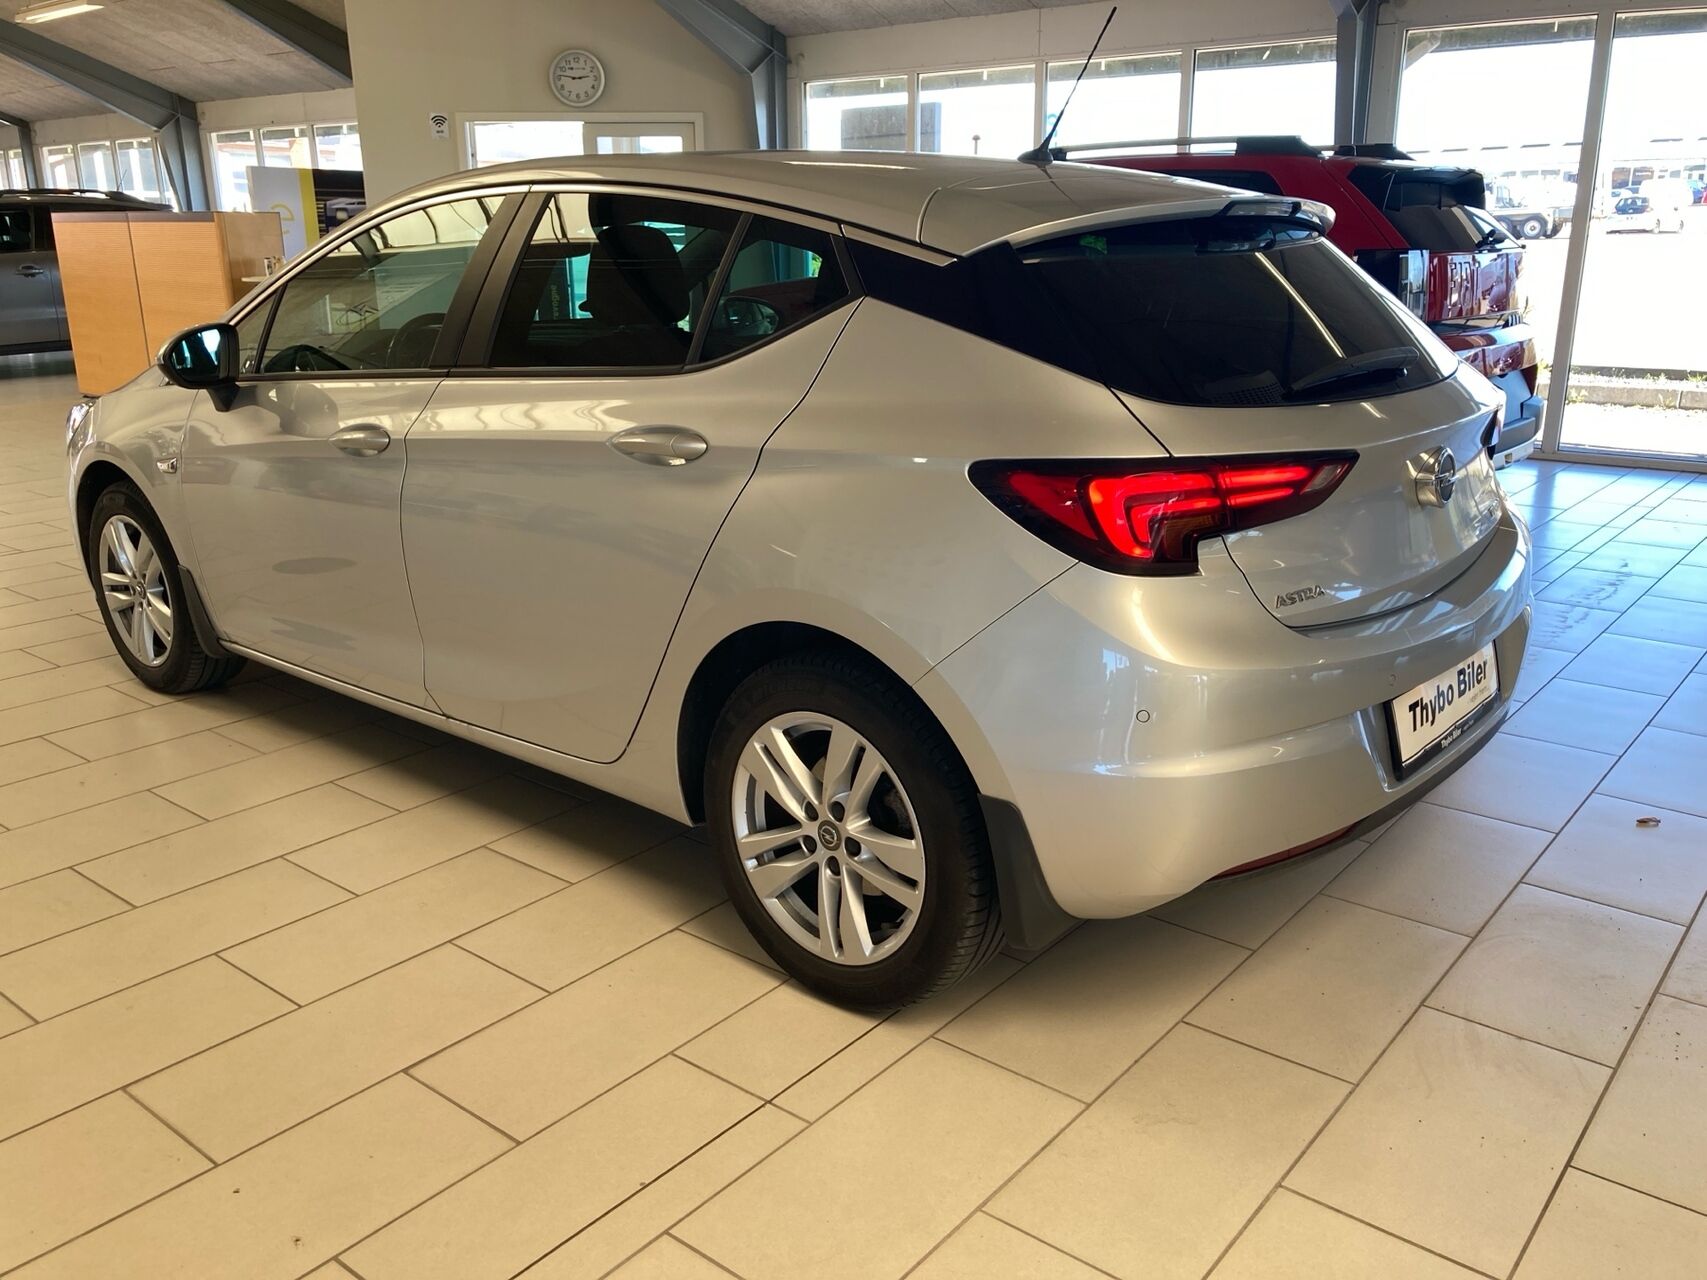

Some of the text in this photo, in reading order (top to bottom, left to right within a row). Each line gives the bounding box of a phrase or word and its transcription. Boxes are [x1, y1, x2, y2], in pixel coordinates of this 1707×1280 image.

[573, 56, 581, 64] 12
[558, 65, 567, 73] 10
[1274, 584, 1327, 609] ASTRA
[1408, 682, 1455, 733] Thybo
[1456, 658, 1489, 700] Biler
